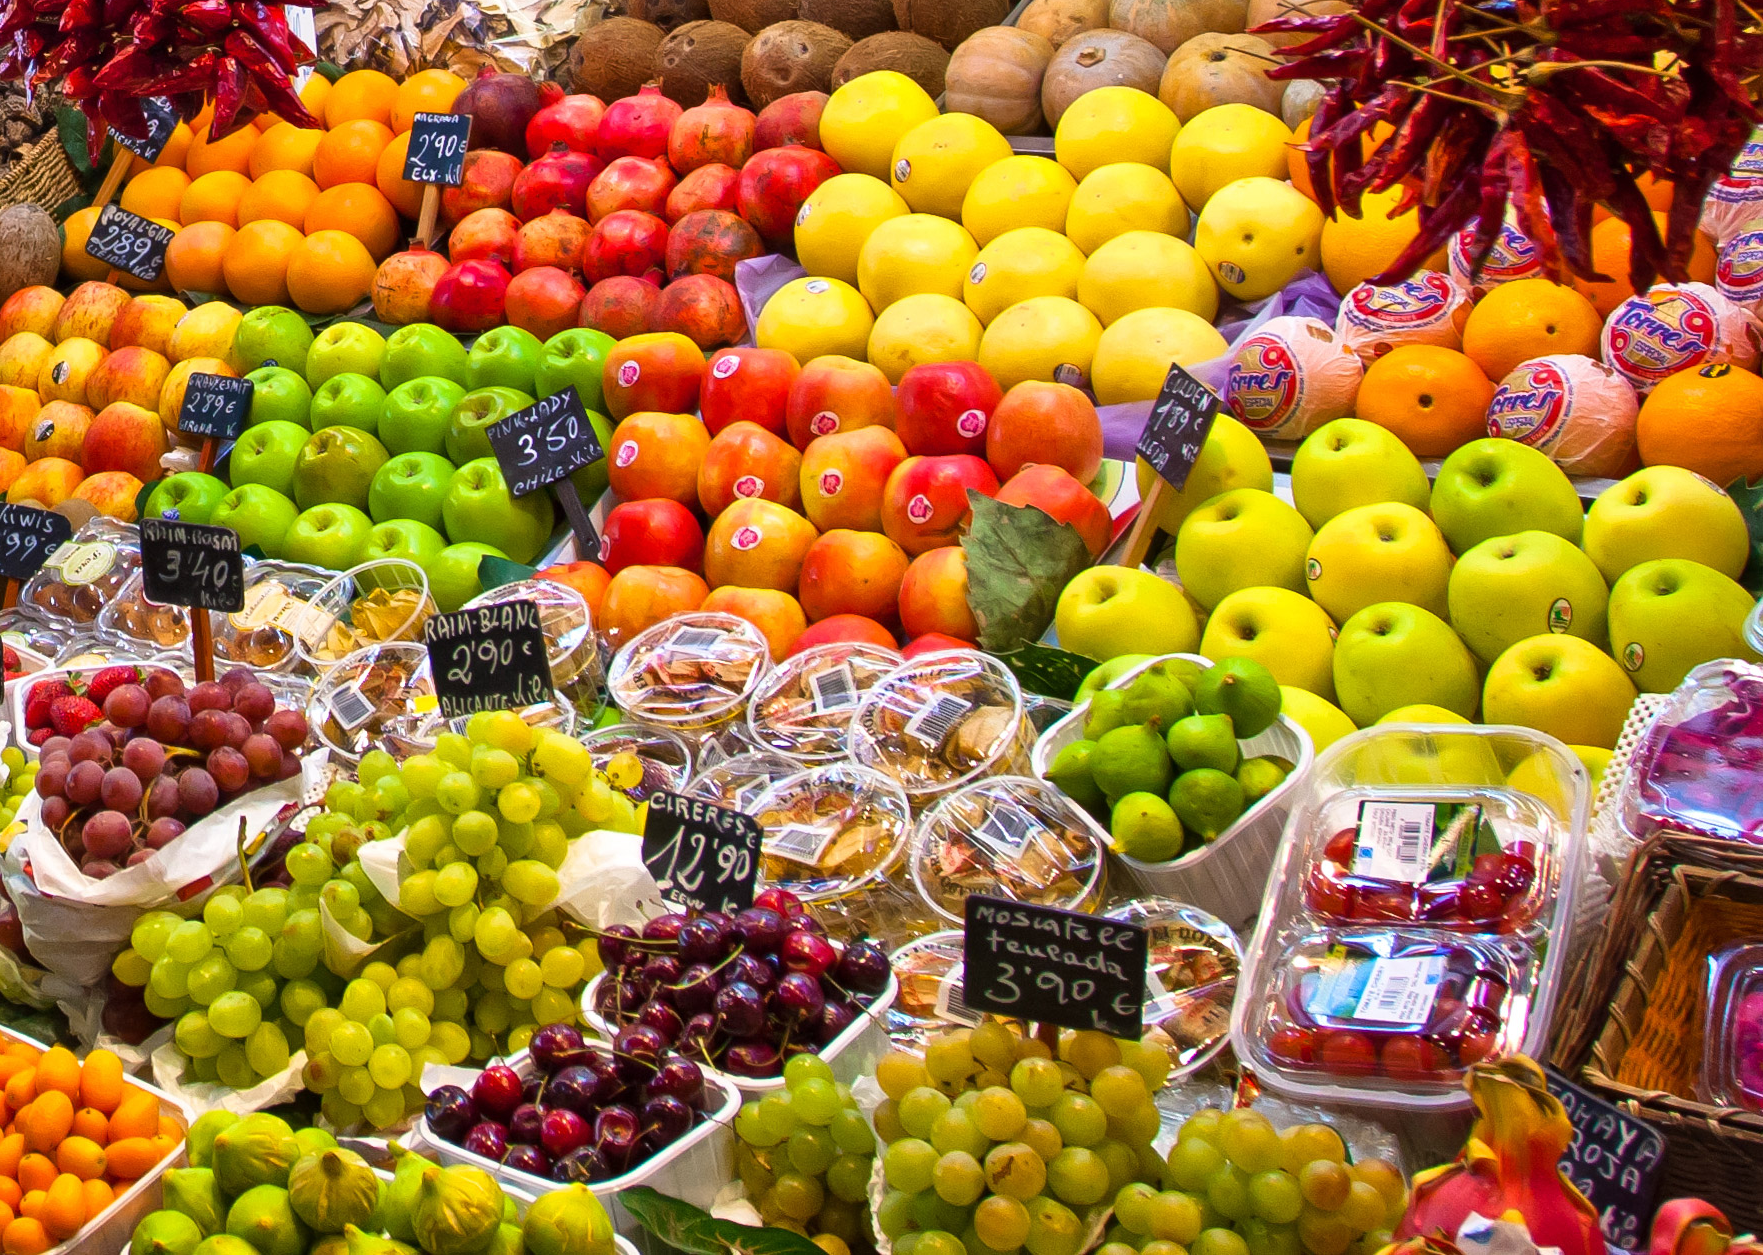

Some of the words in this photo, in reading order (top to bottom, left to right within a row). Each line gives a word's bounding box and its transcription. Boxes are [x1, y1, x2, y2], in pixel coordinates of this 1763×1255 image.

[409, 131, 458, 167] 2'90
[1614, 299, 1708, 354] Torres
[517, 412, 579, 467] 3'50
[158, 549, 229, 588] 3'40
[447, 638, 513, 684] 2'90
[522, 640, 533, 656] €
[650, 791, 746, 837] CIRERES
[645, 825, 751, 892] 12'90
[984, 962, 1096, 1006] 3'90
